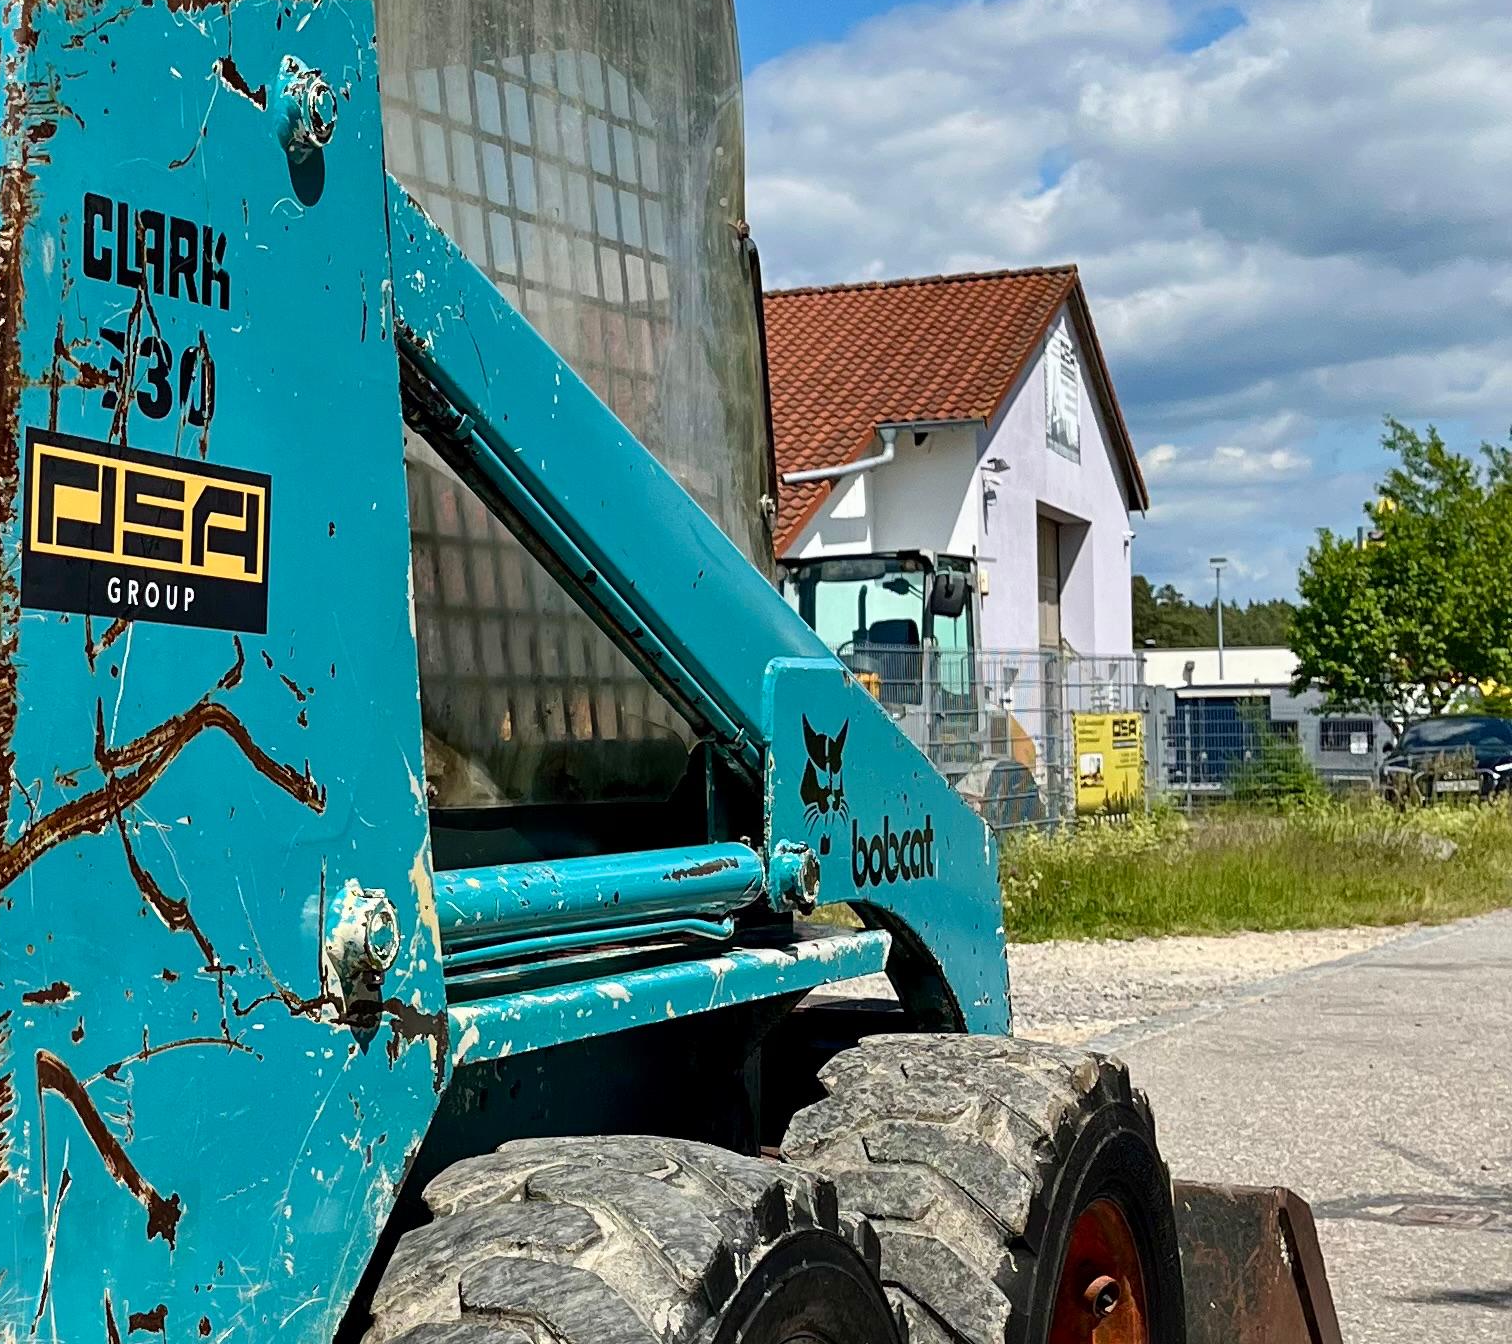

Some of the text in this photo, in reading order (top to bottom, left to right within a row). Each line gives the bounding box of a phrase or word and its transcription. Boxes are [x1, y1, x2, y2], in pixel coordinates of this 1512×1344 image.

[83, 192, 231, 312] CLARK
[107, 577, 197, 613] GROUP
[851, 814, 935, 888] bobcat
